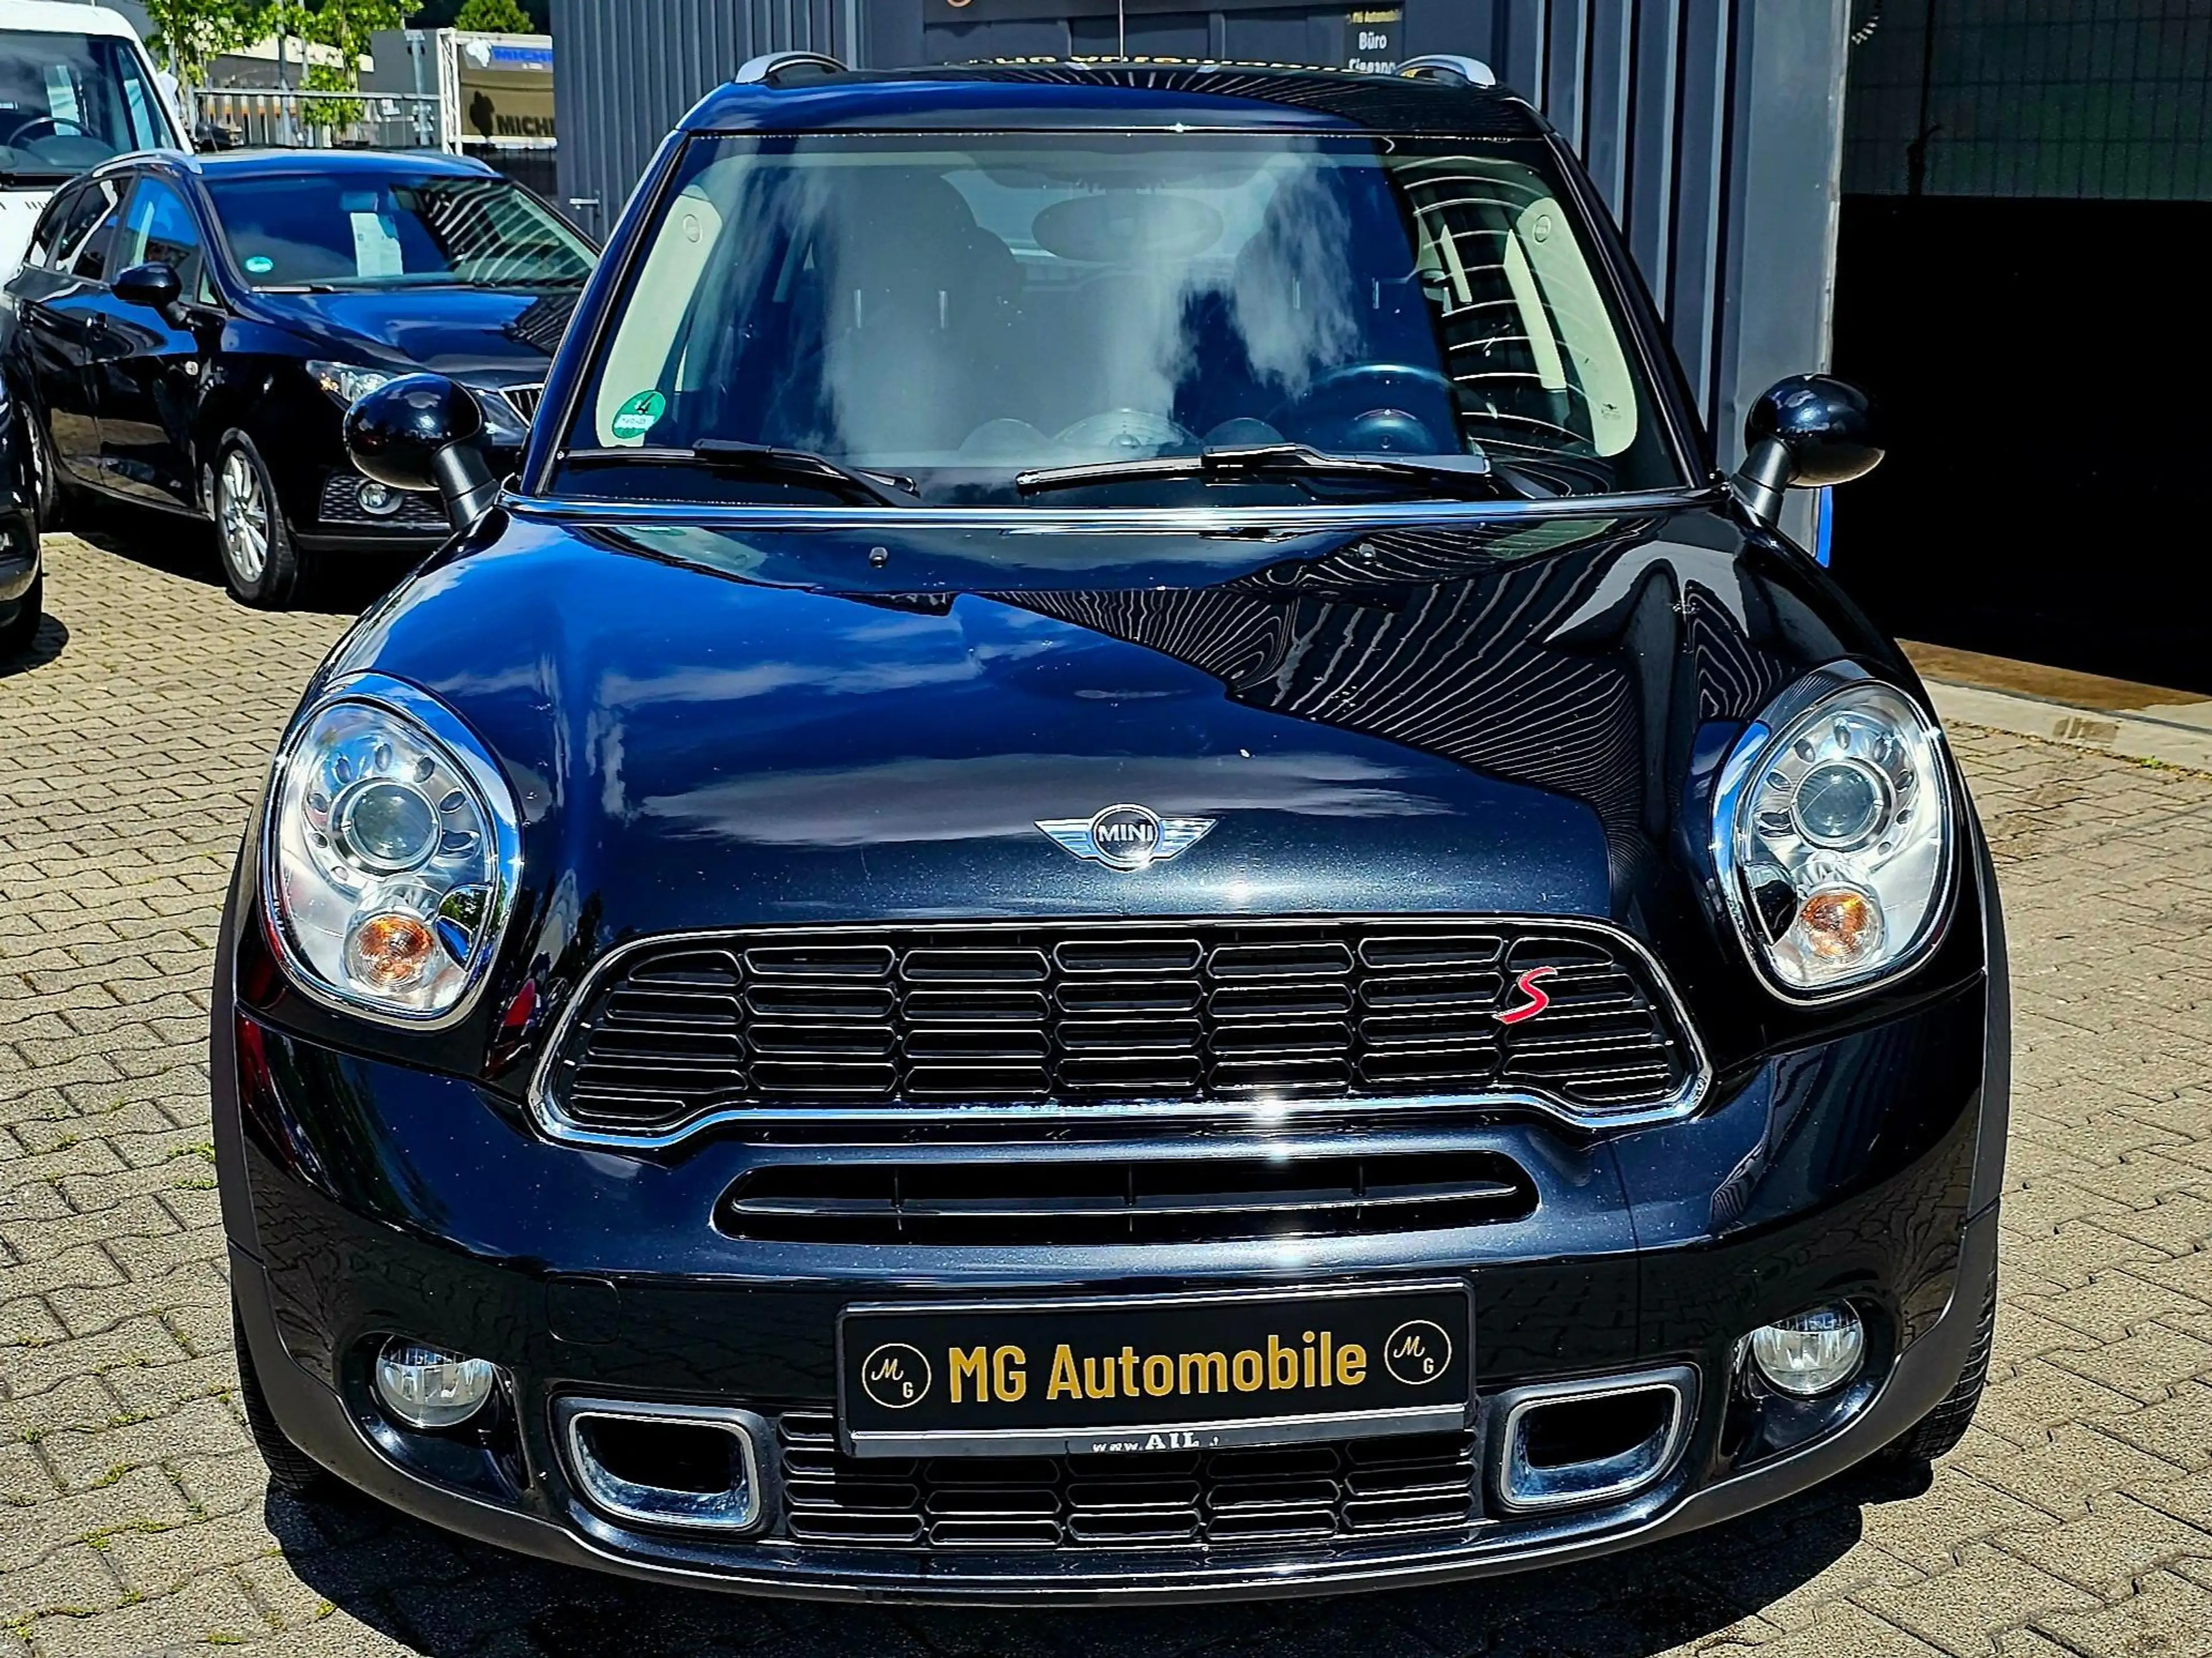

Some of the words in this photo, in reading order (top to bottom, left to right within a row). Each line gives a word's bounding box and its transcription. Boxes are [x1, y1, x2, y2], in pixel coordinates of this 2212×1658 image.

[1358, 31, 1387, 50] Büro
[1098, 824, 1153, 843] MINI
[1491, 965, 1558, 1025] S
[949, 1345, 1026, 1403] MG
[1046, 1330, 1367, 1400] Automobile
